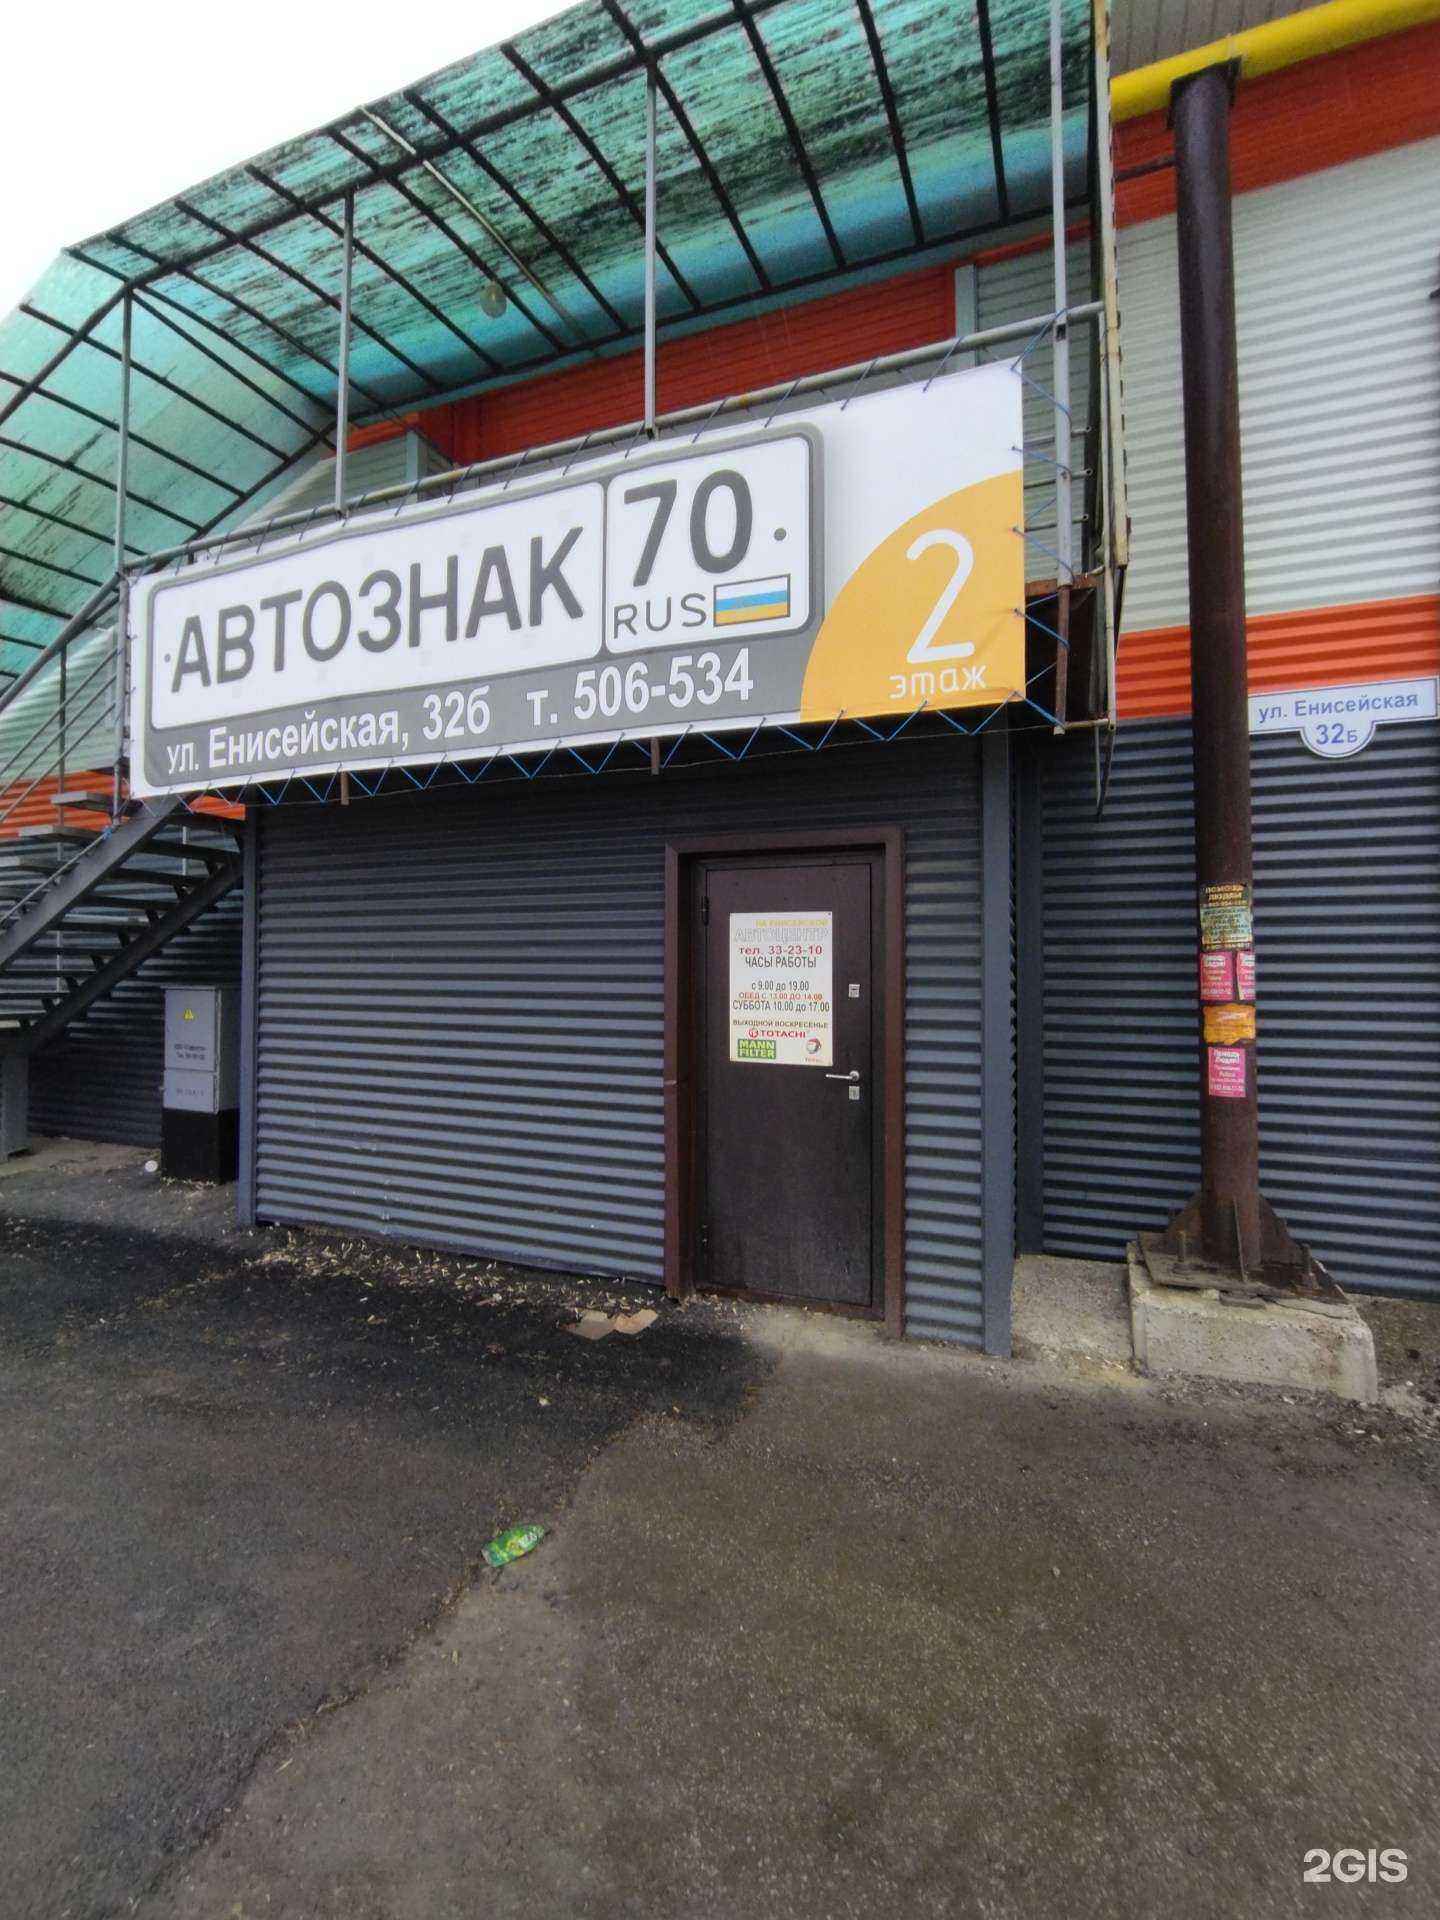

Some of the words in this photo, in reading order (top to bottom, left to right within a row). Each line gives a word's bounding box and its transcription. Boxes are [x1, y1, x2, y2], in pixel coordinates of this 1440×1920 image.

[624, 469, 753, 588] 70
[906, 529, 974, 664] 2
[172, 527, 584, 692] АВТОЗНАК
[614, 593, 707, 640] RUS
[889, 664, 986, 699] этаж
[166, 741, 199, 775] ул.
[209, 709, 409, 770] Енисейская,
[422, 685, 491, 741] 32б
[525, 690, 558, 729] т.
[572, 648, 754, 722] 506-534
[1259, 706, 1288, 723] ул.
[1295, 693, 1418, 716] Енисейская
[768, 945, 823, 955] 33-23-10
[745, 956, 773, 967] ЧАСЫ
[776, 956, 816, 968] РАБОТЫ
[758, 981, 774, 991] 9.00
[776, 983, 786, 991] до
[789, 981, 809, 991] 19.00
[733, 1000, 771, 1011] СУББОТА
[774, 1001, 794, 1011] 10.00
[796, 1004, 806, 1013] до
[809, 1002, 830, 1012] 17.00
[733, 1019, 773, 1027] ВЫХОДНОЙ
[761, 1030, 806, 1038] TOTACHI
[739, 1039, 775, 1050] MANN
[739, 1049, 776, 1059] FILTER
